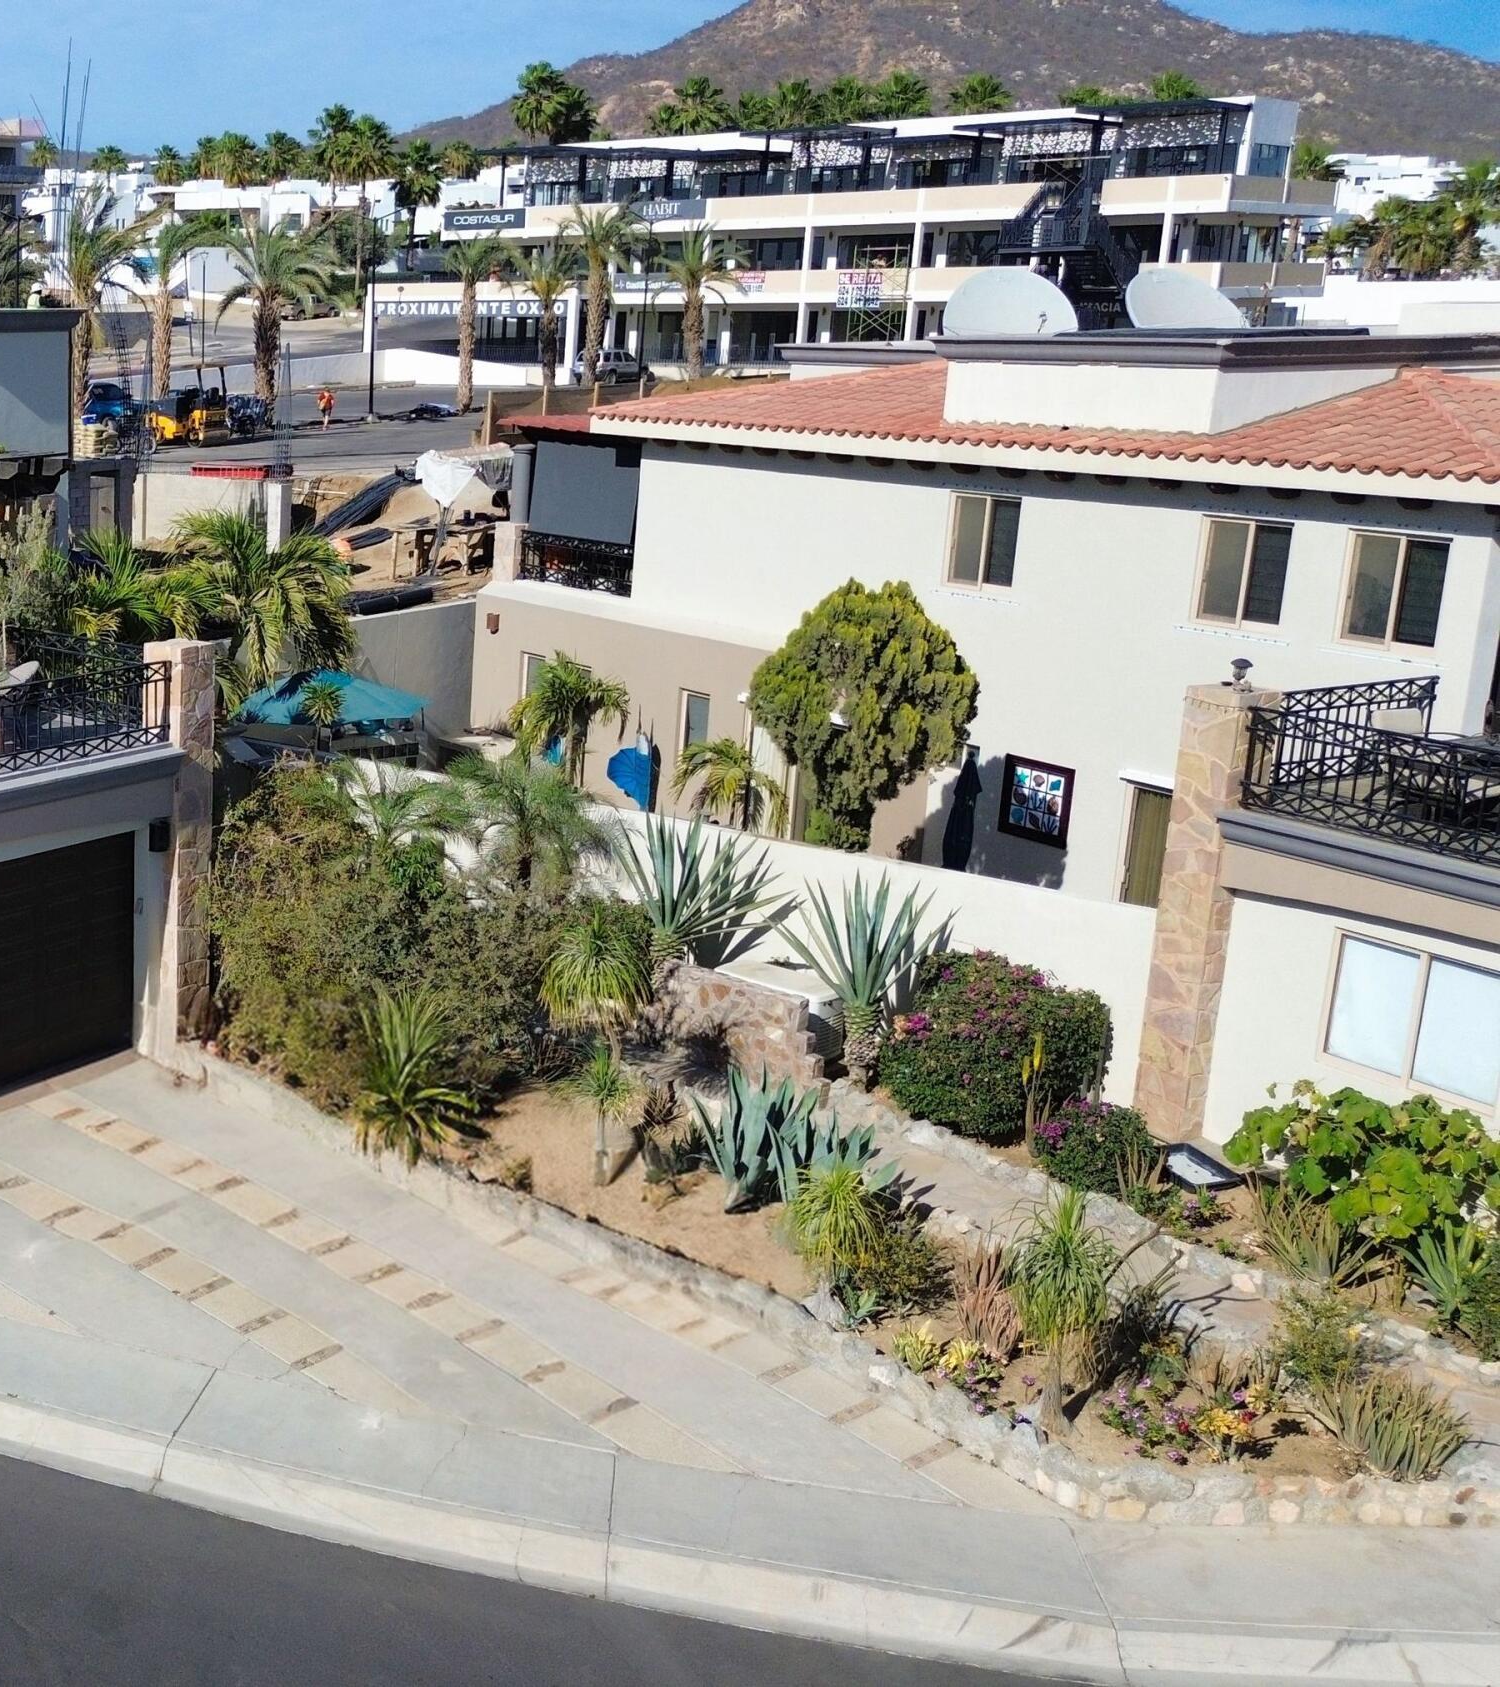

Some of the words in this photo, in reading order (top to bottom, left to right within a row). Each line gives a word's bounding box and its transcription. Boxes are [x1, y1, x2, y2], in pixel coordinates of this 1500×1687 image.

[643, 202, 680, 216] HABIT
[453, 214, 515, 225] COSTASUR
[839, 273, 851, 284] SE
[376, 302, 511, 315] PROXIMAMNTE
[516, 301, 565, 315] OXO
